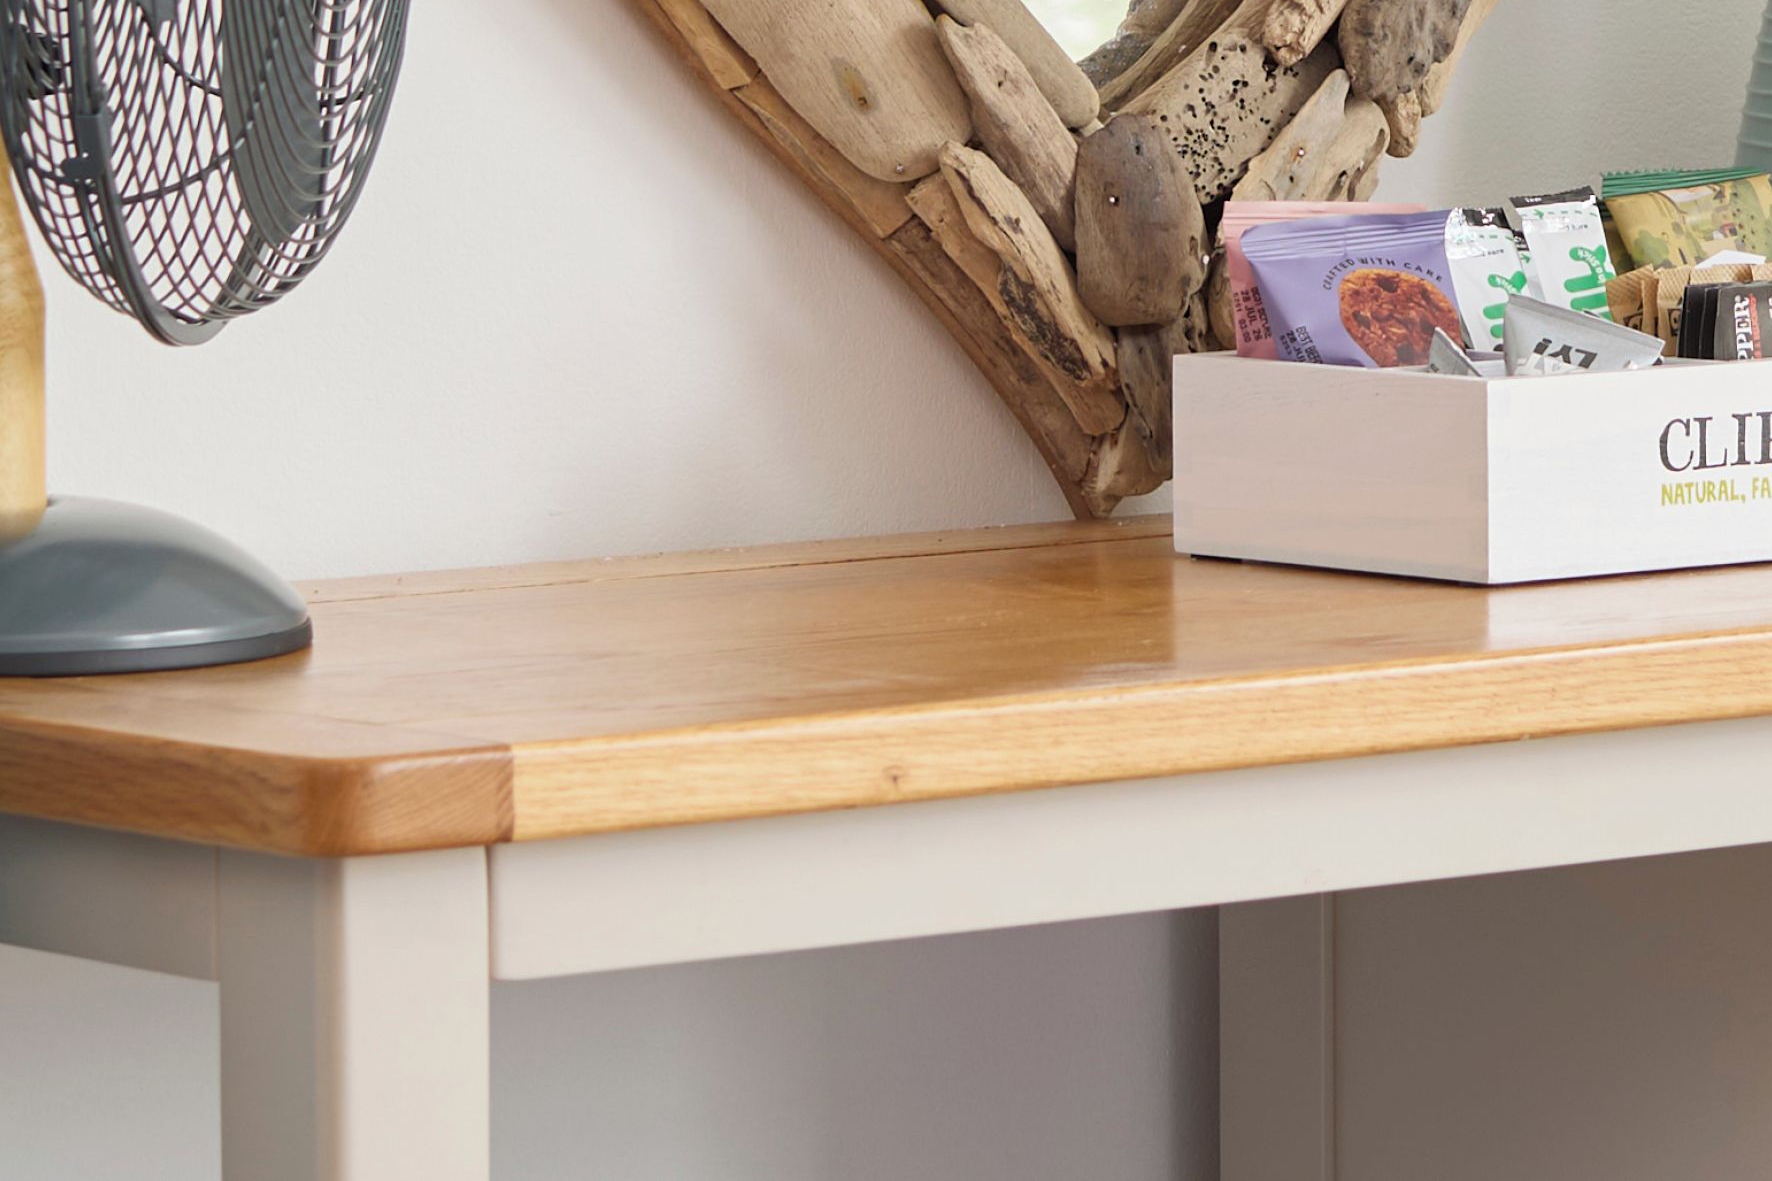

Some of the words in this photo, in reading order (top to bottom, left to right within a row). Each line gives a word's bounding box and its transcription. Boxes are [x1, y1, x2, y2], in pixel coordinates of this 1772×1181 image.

[1322, 259, 1355, 290] CRAFTED
[1359, 257, 1396, 266] WITH
[1403, 262, 1443, 283] CARE
[1245, 305, 1257, 325] JUL
[1296, 325, 1313, 345] BEST
[1293, 347, 1306, 362] JU
[1661, 479, 1746, 506] NATURAL,
